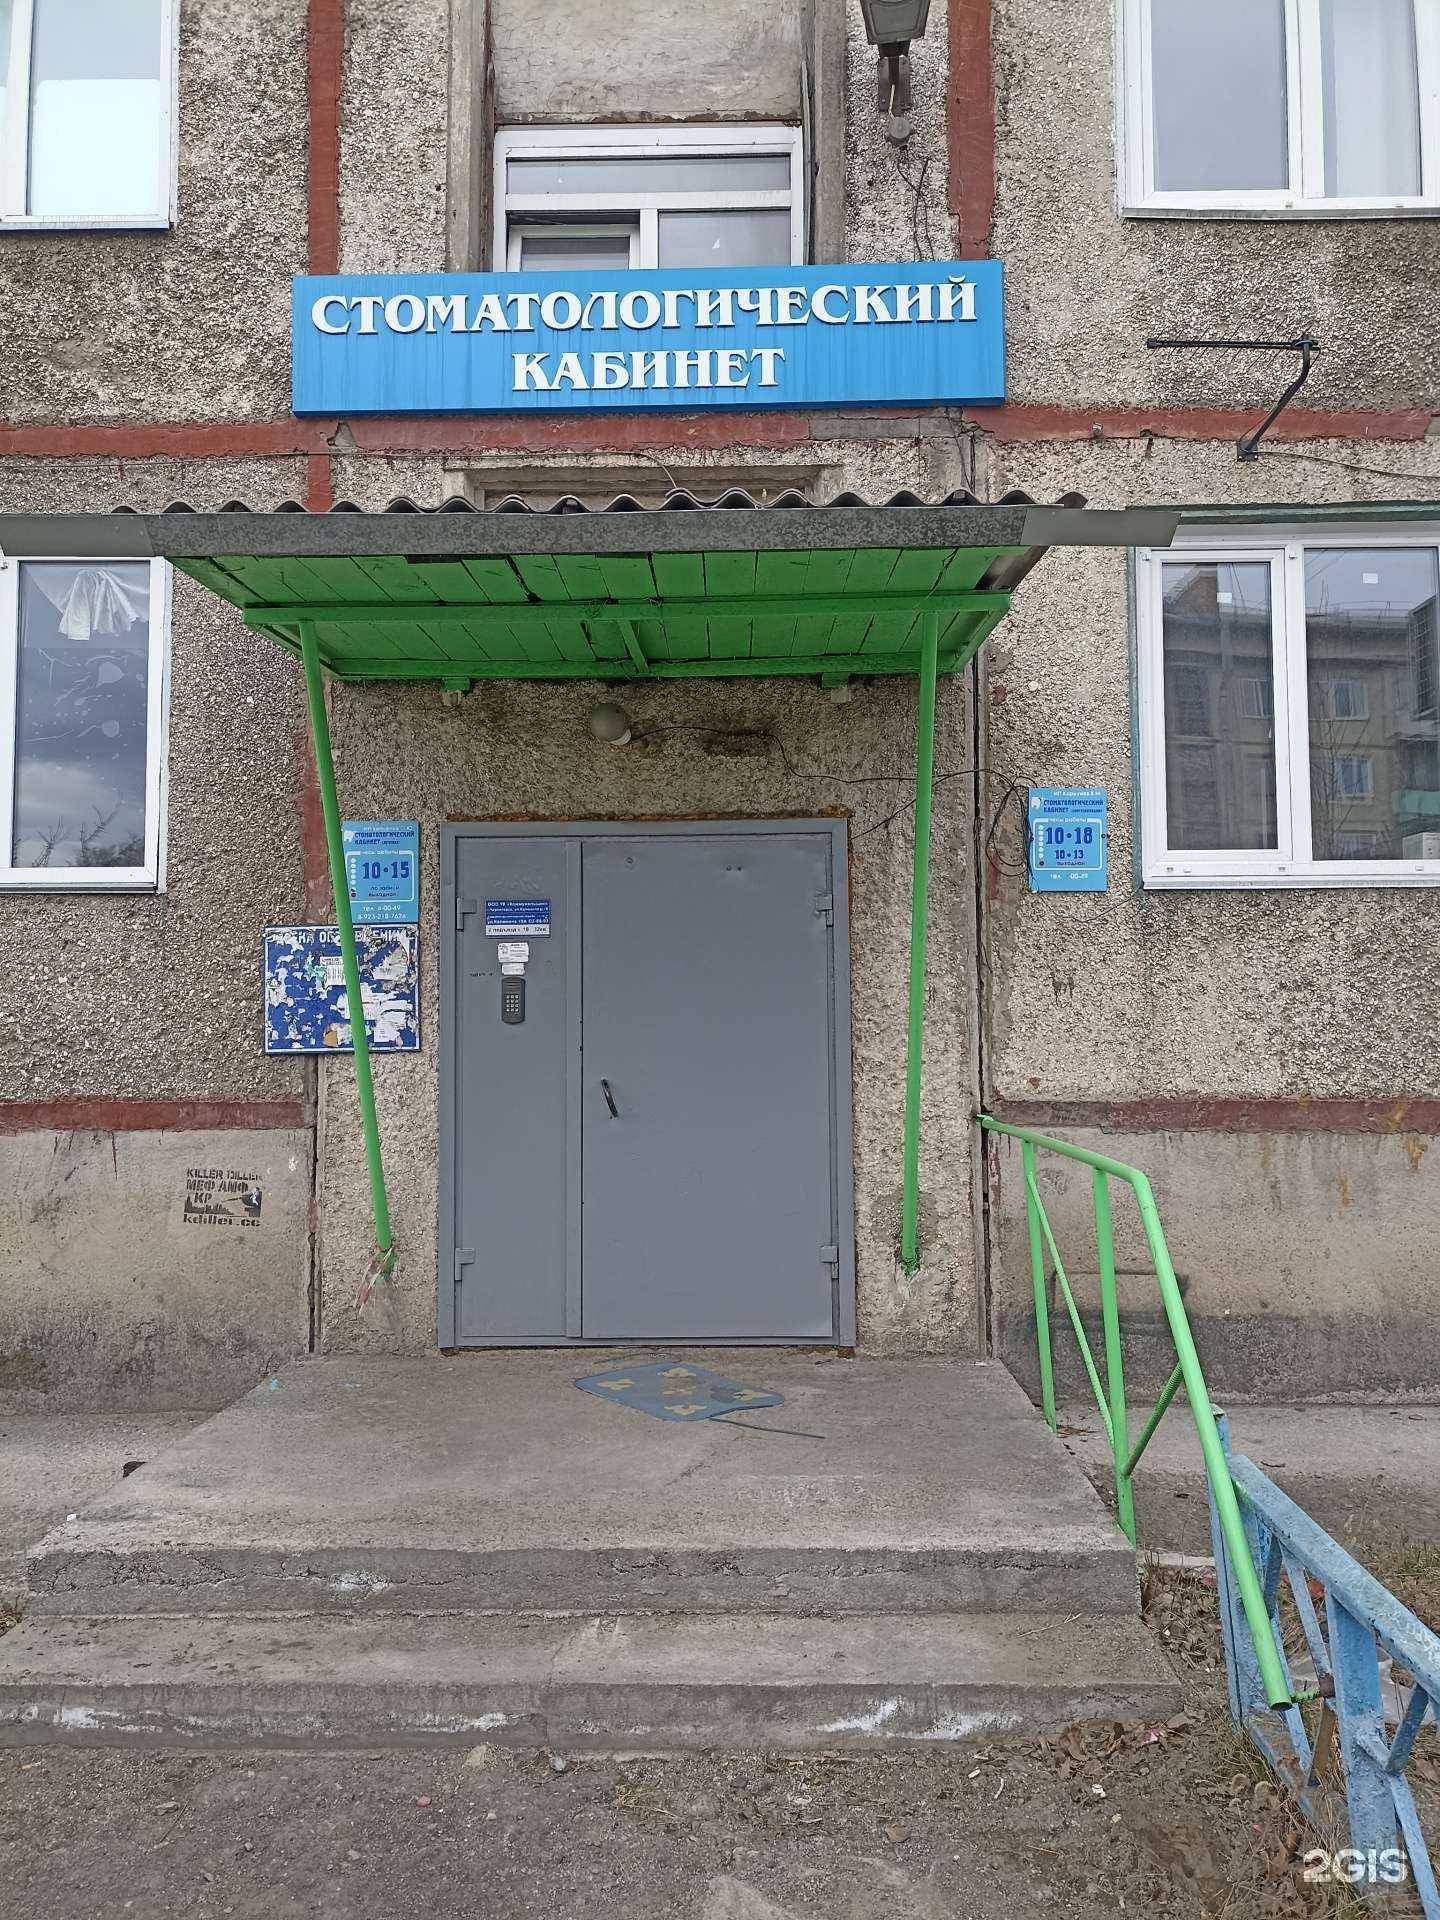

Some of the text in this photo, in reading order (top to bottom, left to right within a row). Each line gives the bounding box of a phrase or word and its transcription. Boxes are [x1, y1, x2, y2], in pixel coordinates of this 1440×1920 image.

[311, 274, 978, 334] СТОМАТОЛОГИЧЕСКИЙ
[511, 347, 786, 391] КАБИНЕТ
[1043, 798, 1104, 806] СТОМАТОЛОГИЧЕСКИЙ
[186, 1168, 224, 1180] KILLER
